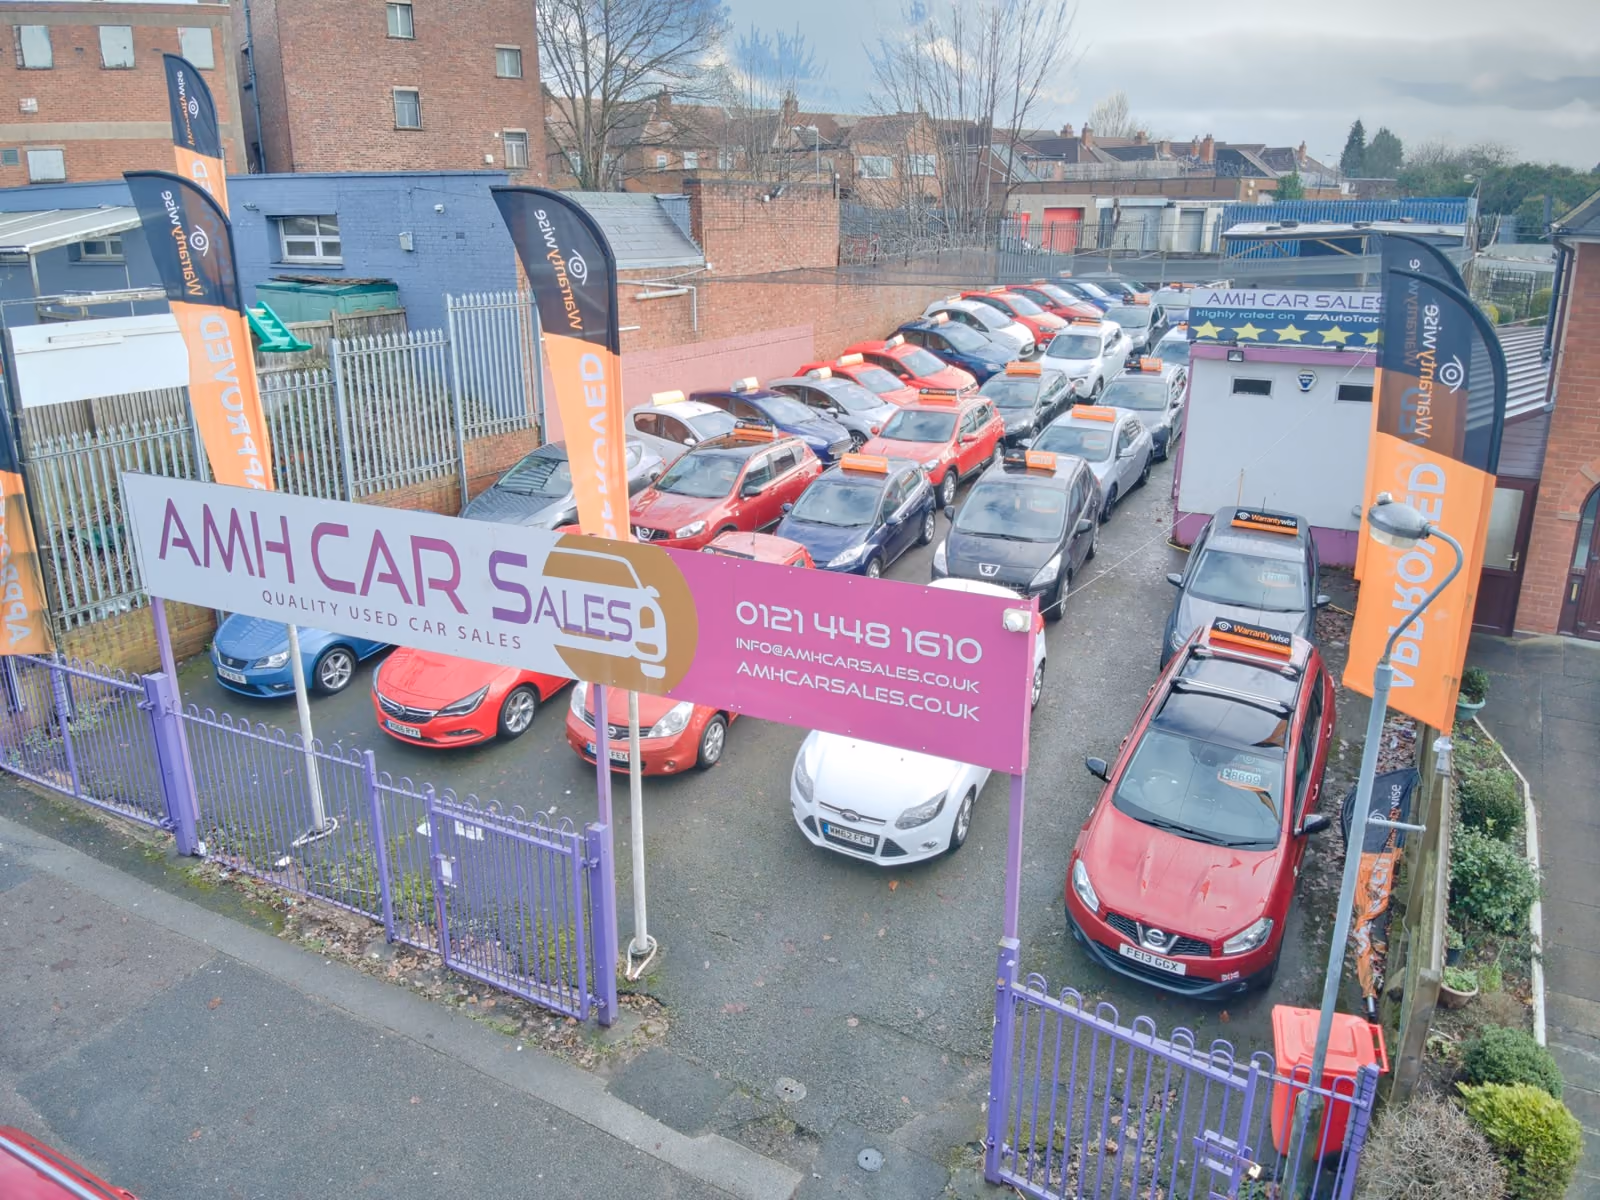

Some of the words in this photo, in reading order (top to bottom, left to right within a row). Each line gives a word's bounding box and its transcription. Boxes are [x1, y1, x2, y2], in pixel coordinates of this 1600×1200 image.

[1196, 310, 1236, 320] Highly
[1239, 311, 1275, 320] rated
[1278, 312, 1295, 321] on
[1206, 292, 1256, 306] AMH
[1262, 293, 1309, 308] CAR
[1251, 514, 1296, 526] Warrantywise
[158, 498, 295, 584] AMH
[311, 521, 468, 615] CAR
[488, 550, 633, 642] SALES
[262, 590, 340, 616] QUALITY
[349, 605, 398, 627] USED
[409, 617, 447, 637] CAR
[458, 626, 522, 650] SALES
[736, 600, 804, 634] 0121
[813, 612, 891, 648] 448
[901, 627, 983, 664] 1610
[1233, 625, 1290, 644] Warrantywise
[736, 637, 980, 694] INFO@AMHCARSALES.CO.UK
[736, 661, 980, 722] AMHCARSALES.CO.UK
[1126, 947, 1152, 962] FE13
[1155, 959, 1179, 971] GGX
